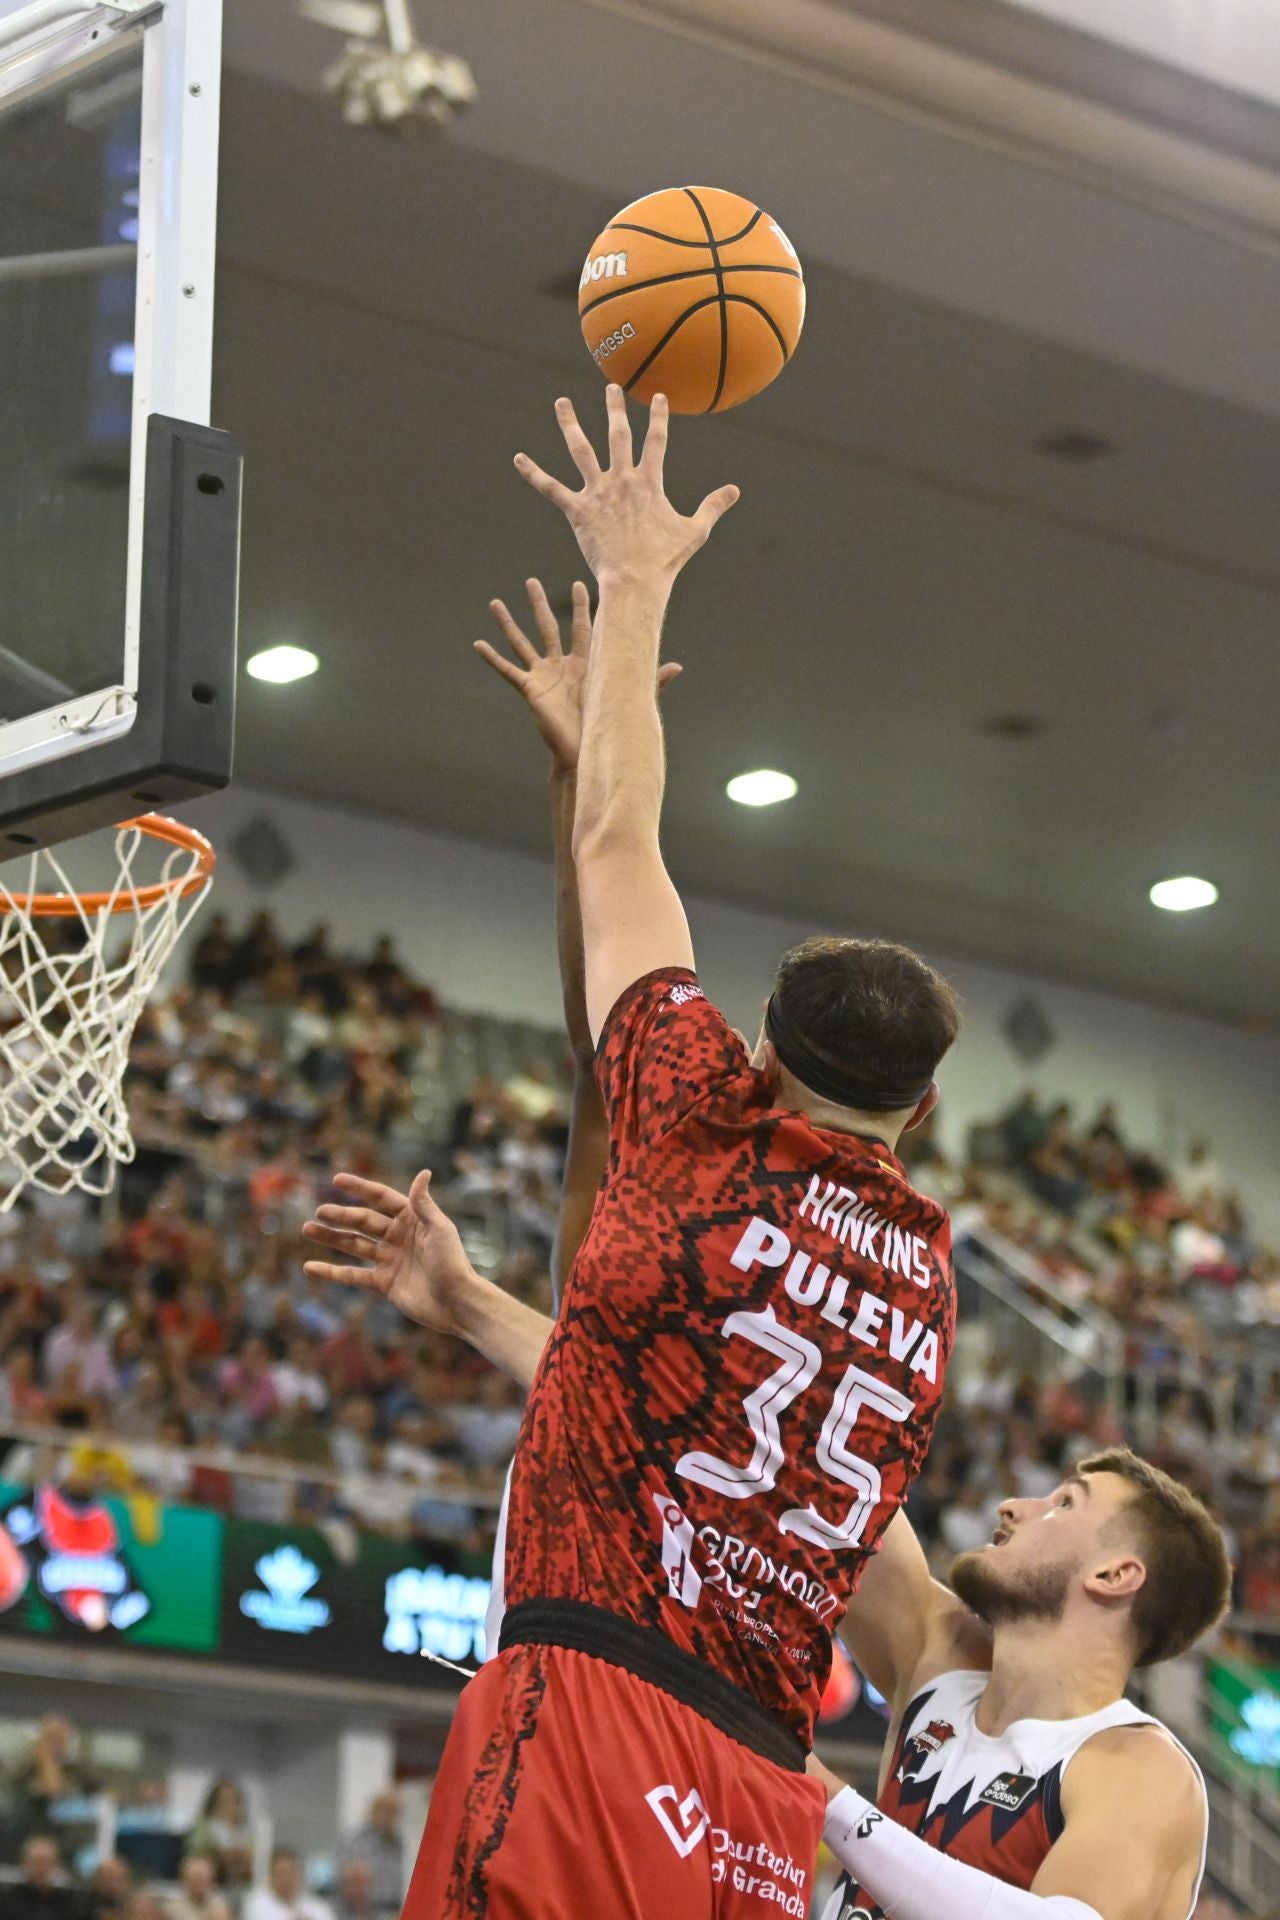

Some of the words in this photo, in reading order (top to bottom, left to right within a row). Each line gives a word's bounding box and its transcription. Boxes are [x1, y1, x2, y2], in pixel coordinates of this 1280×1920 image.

[730, 1216, 938, 1385] PULEVA
[799, 1173, 930, 1289] HANKINS
[675, 1302, 916, 1550] 35
[984, 1788, 1019, 1805] endesa
